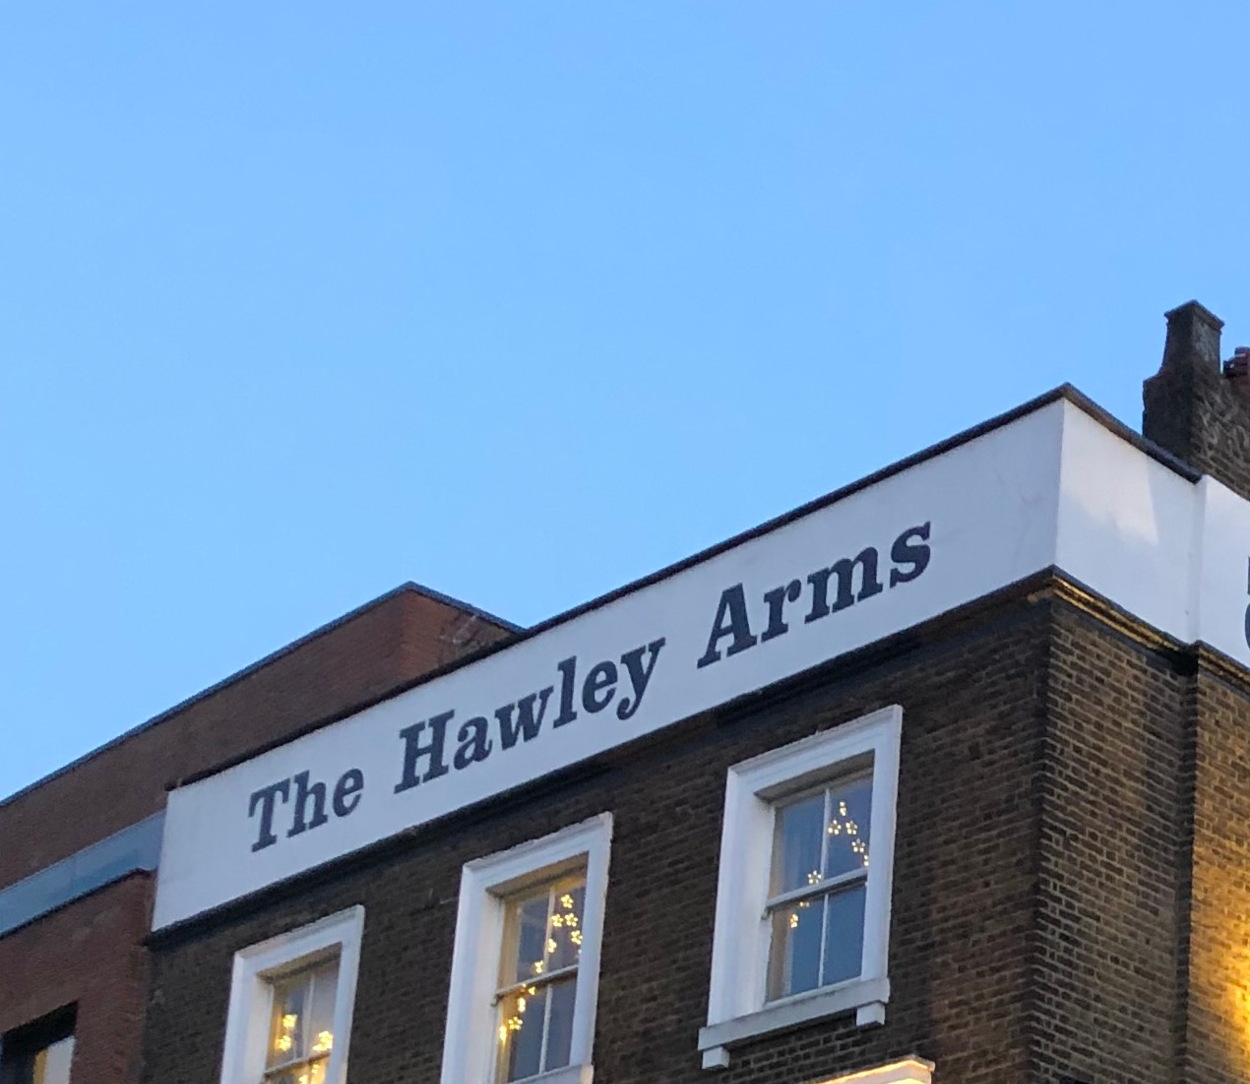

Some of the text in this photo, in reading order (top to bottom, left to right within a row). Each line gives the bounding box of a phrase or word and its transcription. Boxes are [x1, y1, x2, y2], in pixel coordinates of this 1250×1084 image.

[248, 519, 932, 853] The Hawley Arms
